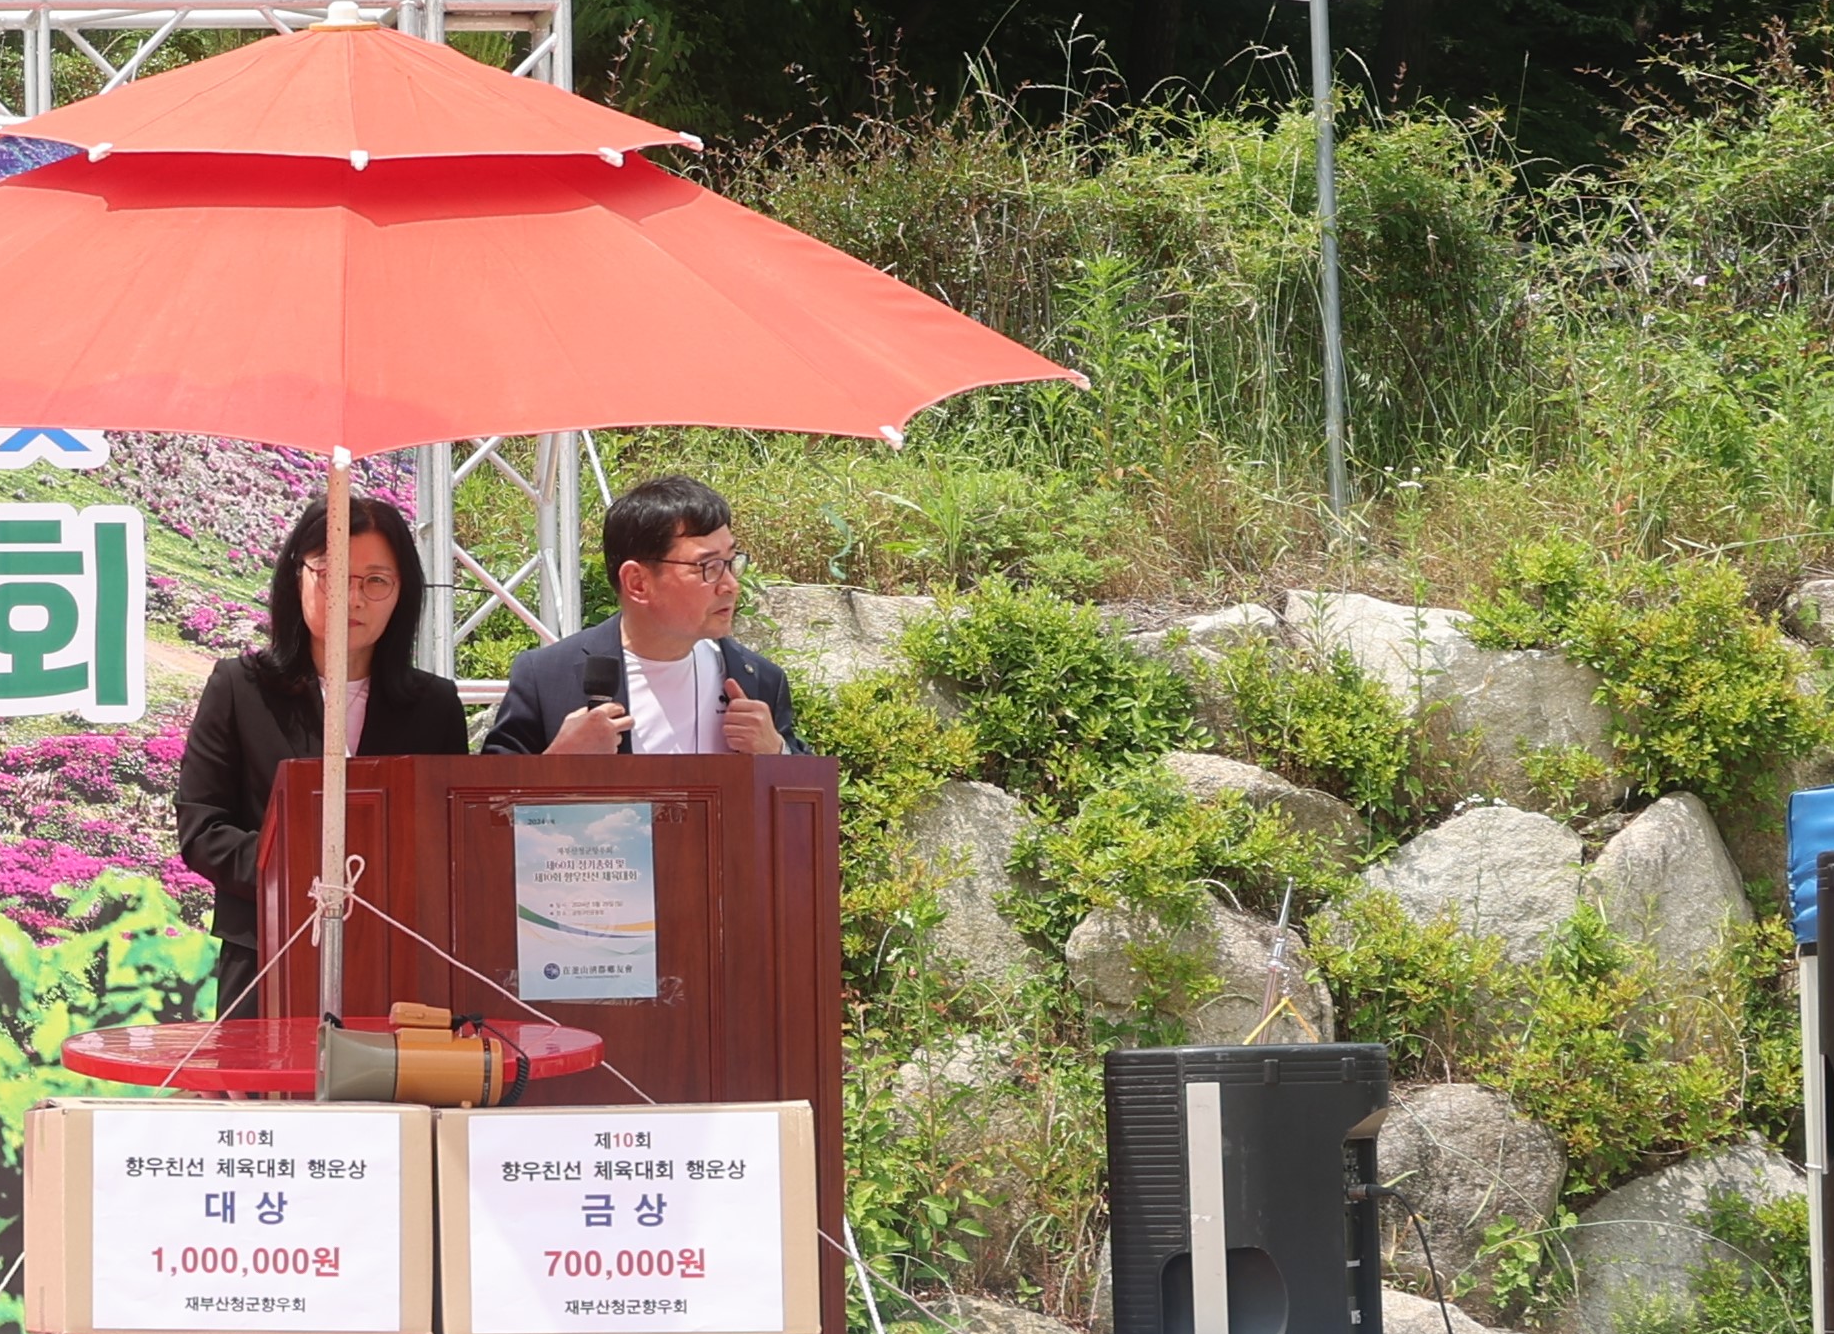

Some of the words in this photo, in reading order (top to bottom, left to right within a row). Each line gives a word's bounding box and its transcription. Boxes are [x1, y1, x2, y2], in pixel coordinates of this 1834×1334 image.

[218, 1130, 273, 1147] 제10회
[595, 1132, 651, 1149] 제10회
[126, 1157, 204, 1177] 향우친선
[217, 1158, 294, 1178] 체육대회
[308, 1159, 367, 1179] 행운상
[502, 1161, 581, 1182] 향우친선
[594, 1160, 673, 1180] 체육대회
[686, 1160, 746, 1180] 행운상
[205, 1191, 235, 1224] 대
[256, 1192, 288, 1225] 상
[582, 1194, 615, 1227] 금
[634, 1193, 667, 1227] 상
[152, 1247, 339, 1277] 1,000,000원
[544, 1248, 705, 1280] 700,000원
[185, 1297, 305, 1312] 재부산청군향우회
[565, 1299, 687, 1315] 재부산청군향우회
